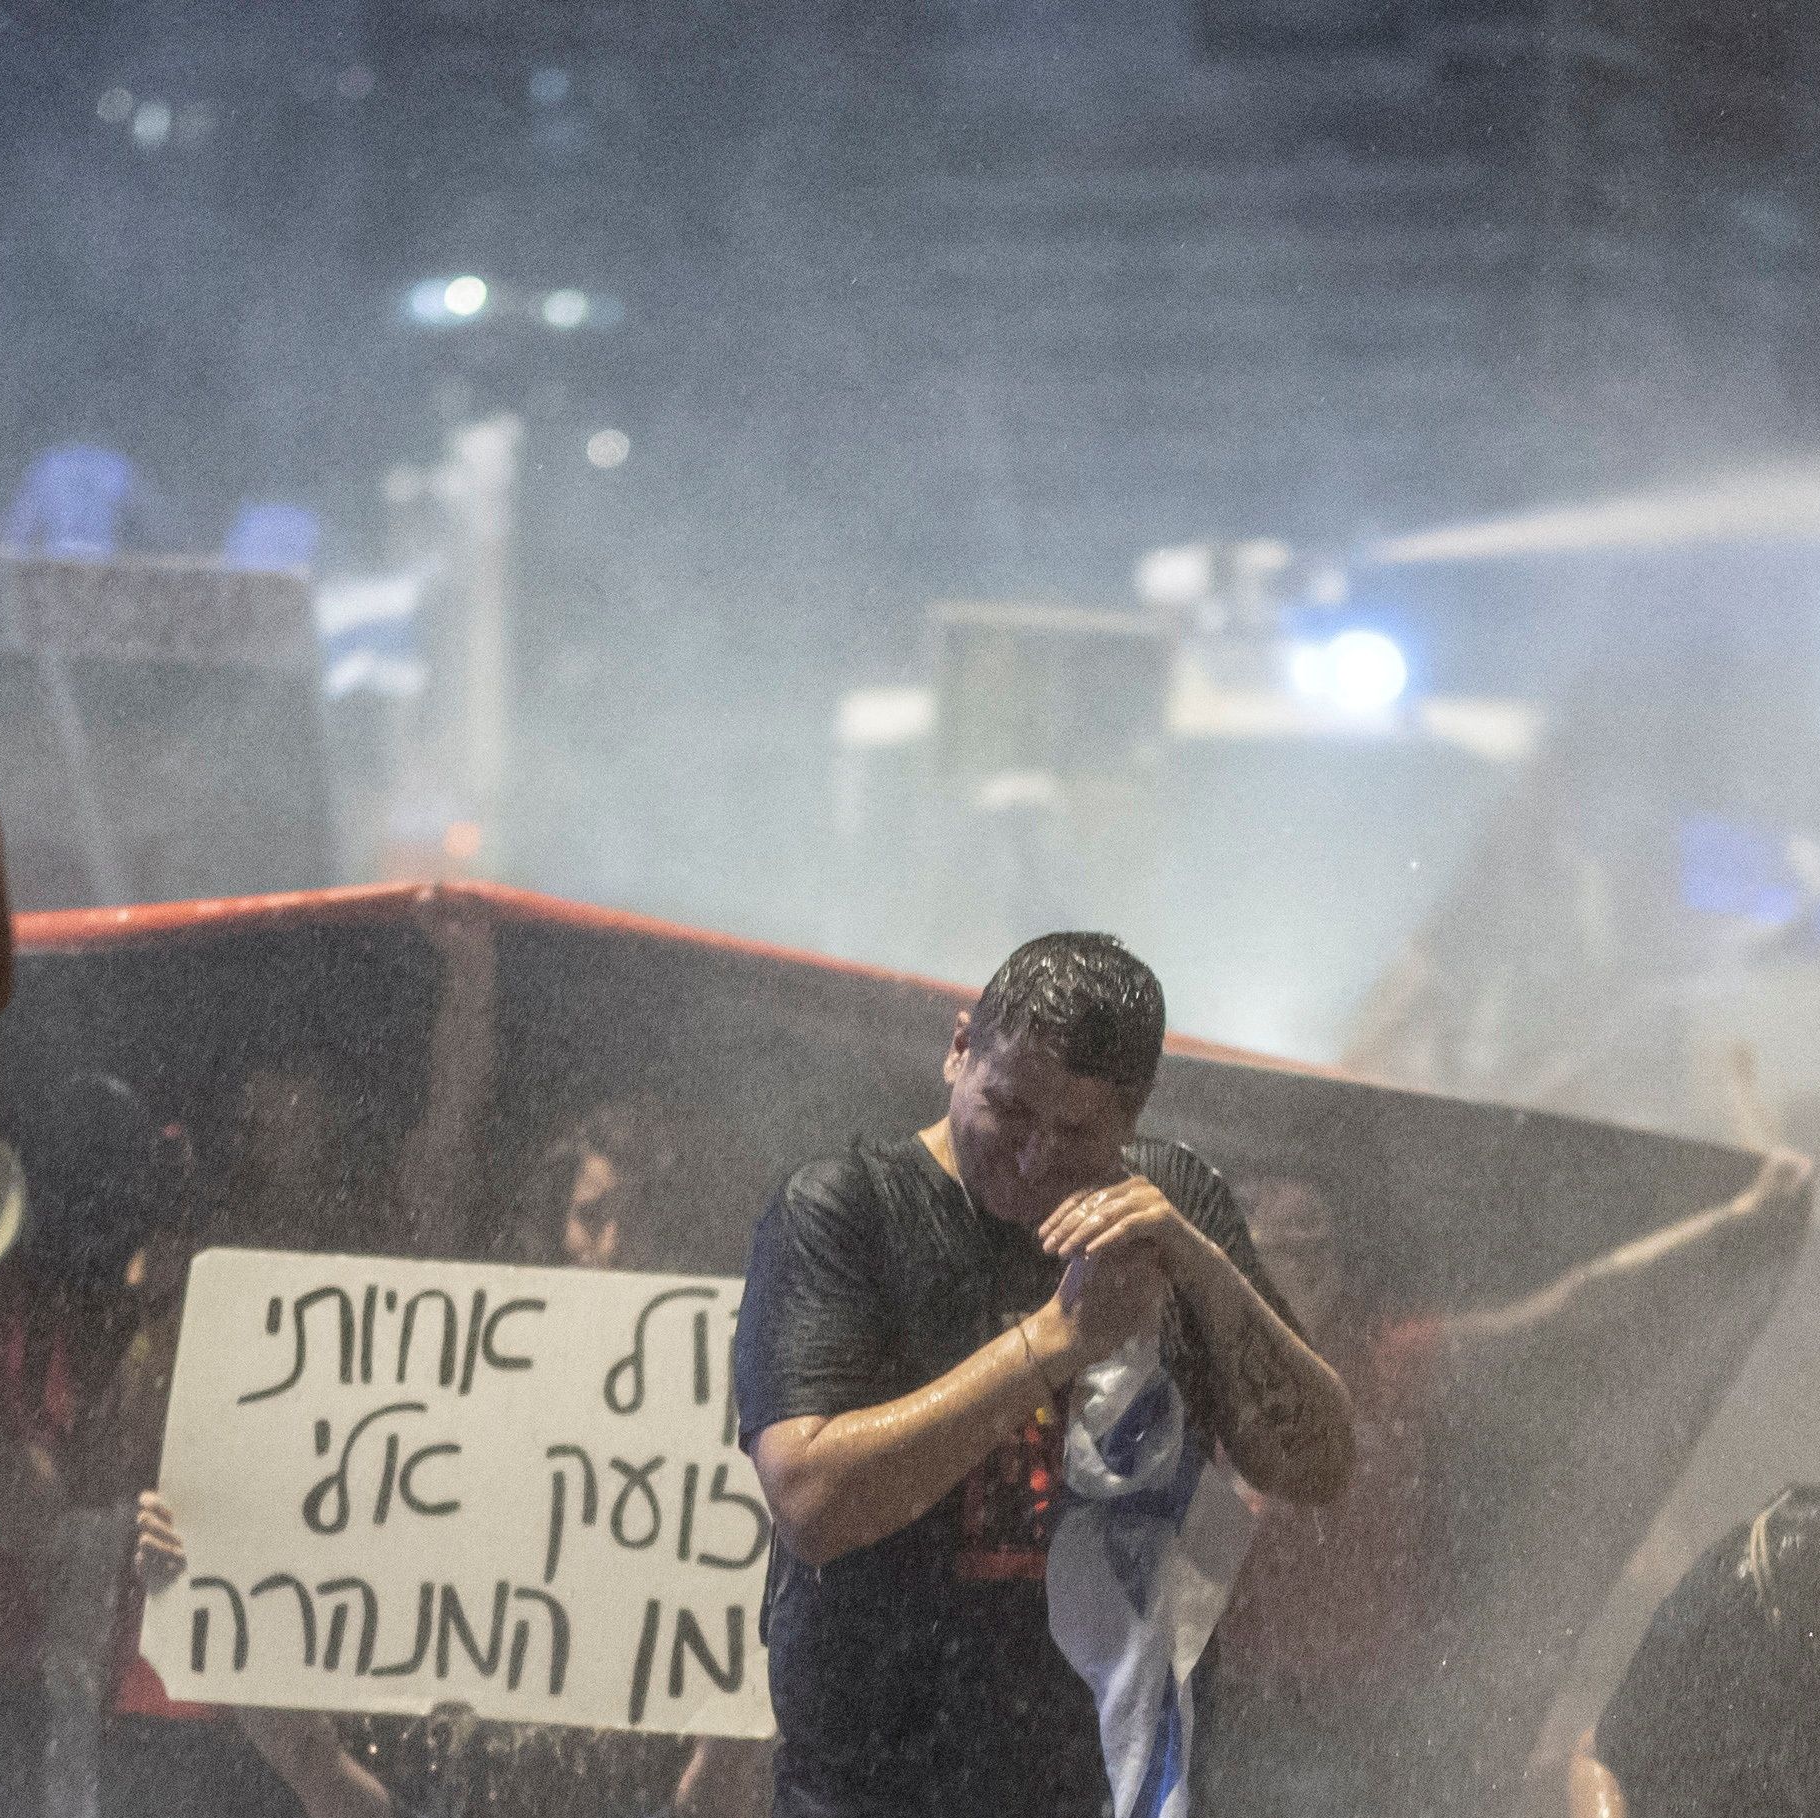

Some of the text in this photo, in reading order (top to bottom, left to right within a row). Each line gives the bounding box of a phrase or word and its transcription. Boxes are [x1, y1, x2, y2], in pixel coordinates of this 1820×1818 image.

[236, 1283, 549, 1406] אחיותי
[302, 1401, 464, 1535] אלי
[188, 1572, 745, 1727] מן המנהרה
